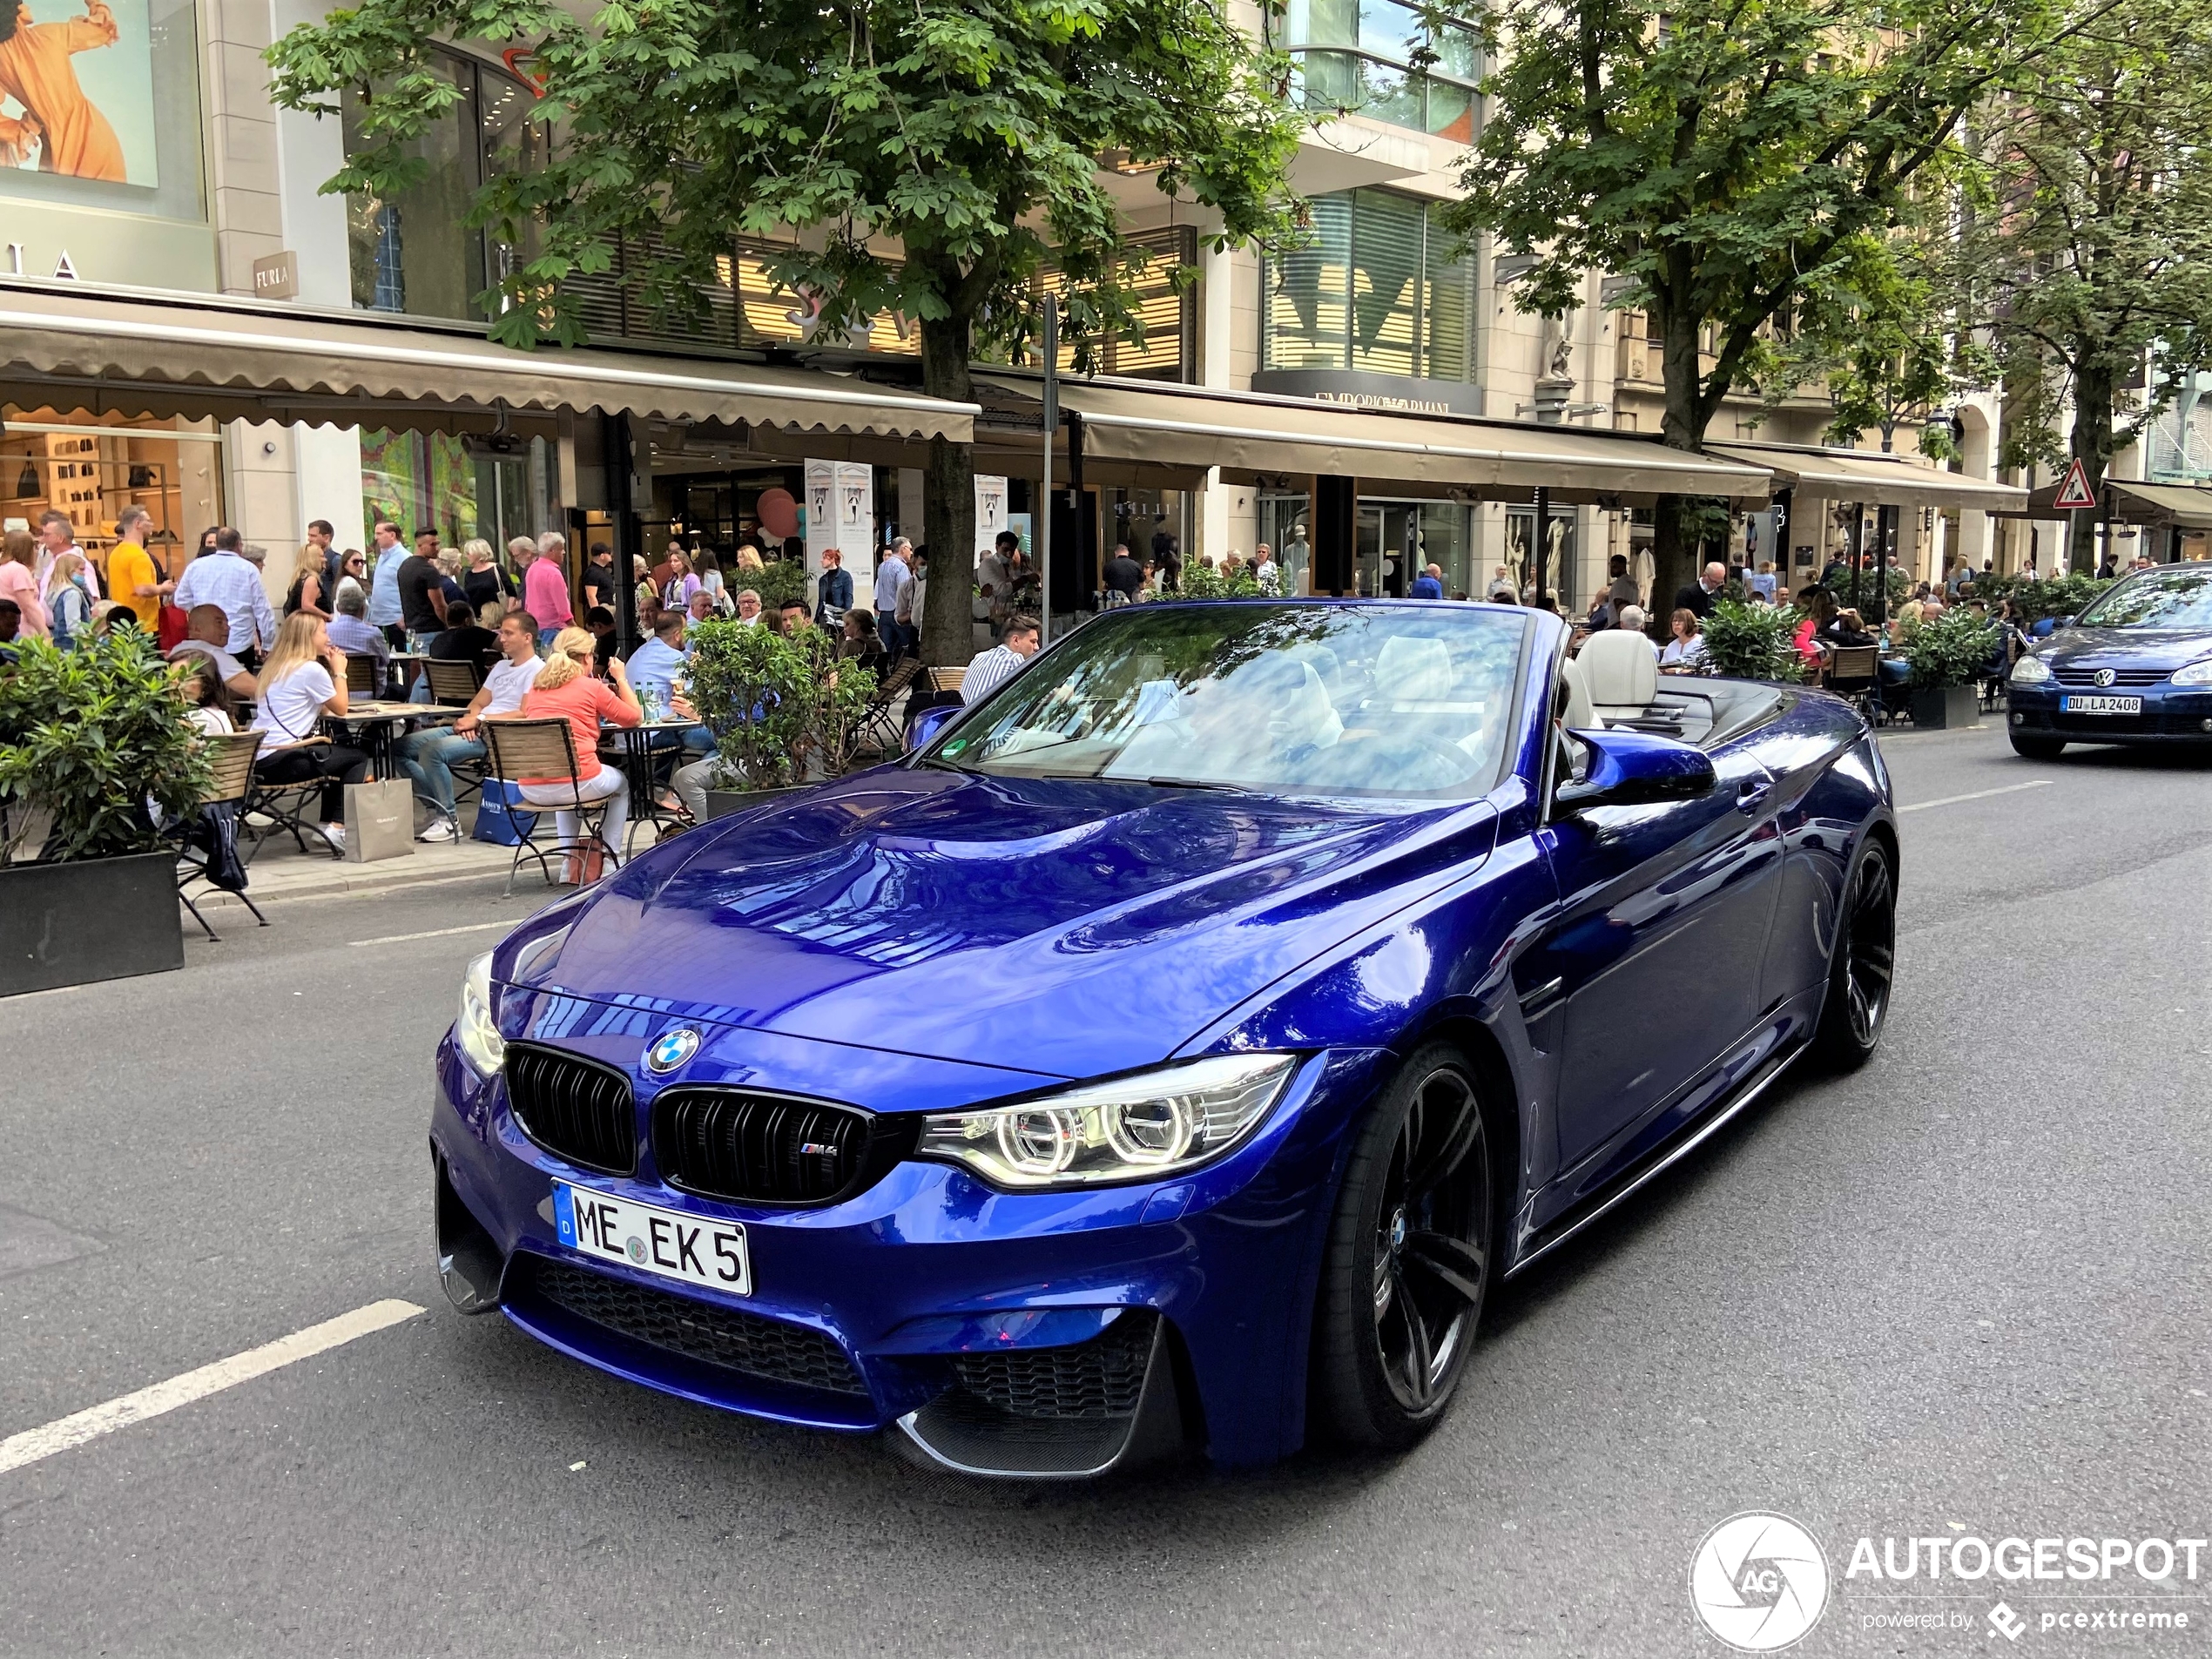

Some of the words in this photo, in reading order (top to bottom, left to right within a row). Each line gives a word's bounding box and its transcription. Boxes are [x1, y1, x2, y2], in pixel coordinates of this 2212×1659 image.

[257, 266, 288, 288] FURLA
[2068, 698, 2083, 709] DU
[2091, 698, 2106, 710] LA
[2108, 699, 2139, 711] 2408
[562, 1220, 570, 1235] D
[574, 1196, 624, 1255] ME
[649, 1217, 706, 1277] EK
[714, 1231, 741, 1282] 5
